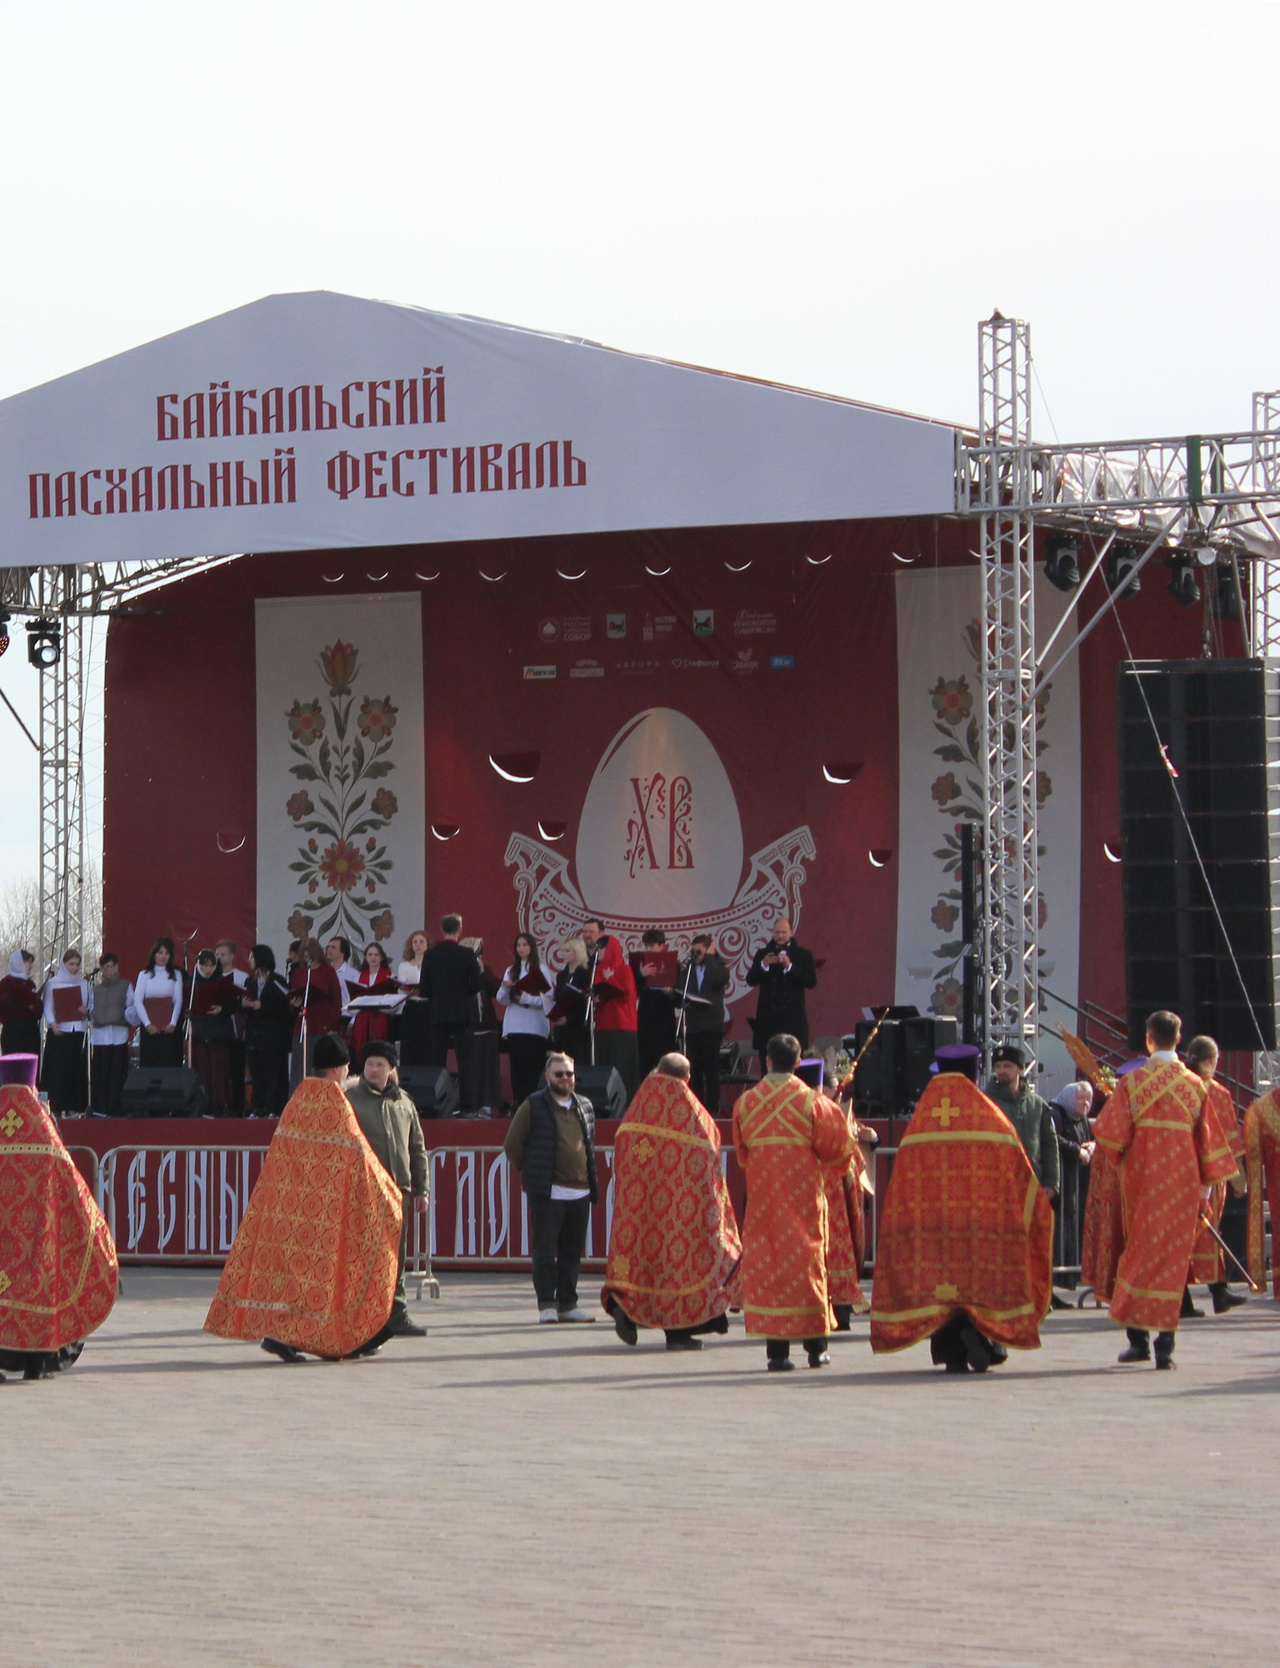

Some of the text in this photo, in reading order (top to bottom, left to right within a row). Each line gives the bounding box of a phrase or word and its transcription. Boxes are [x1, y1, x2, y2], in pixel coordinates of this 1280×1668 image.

[156, 366, 446, 441] БАЙКАЛЬСКИЙ
[28, 439, 588, 519] ПАСХАЛЬНЫЙ ФЕСТИВАЛЬ
